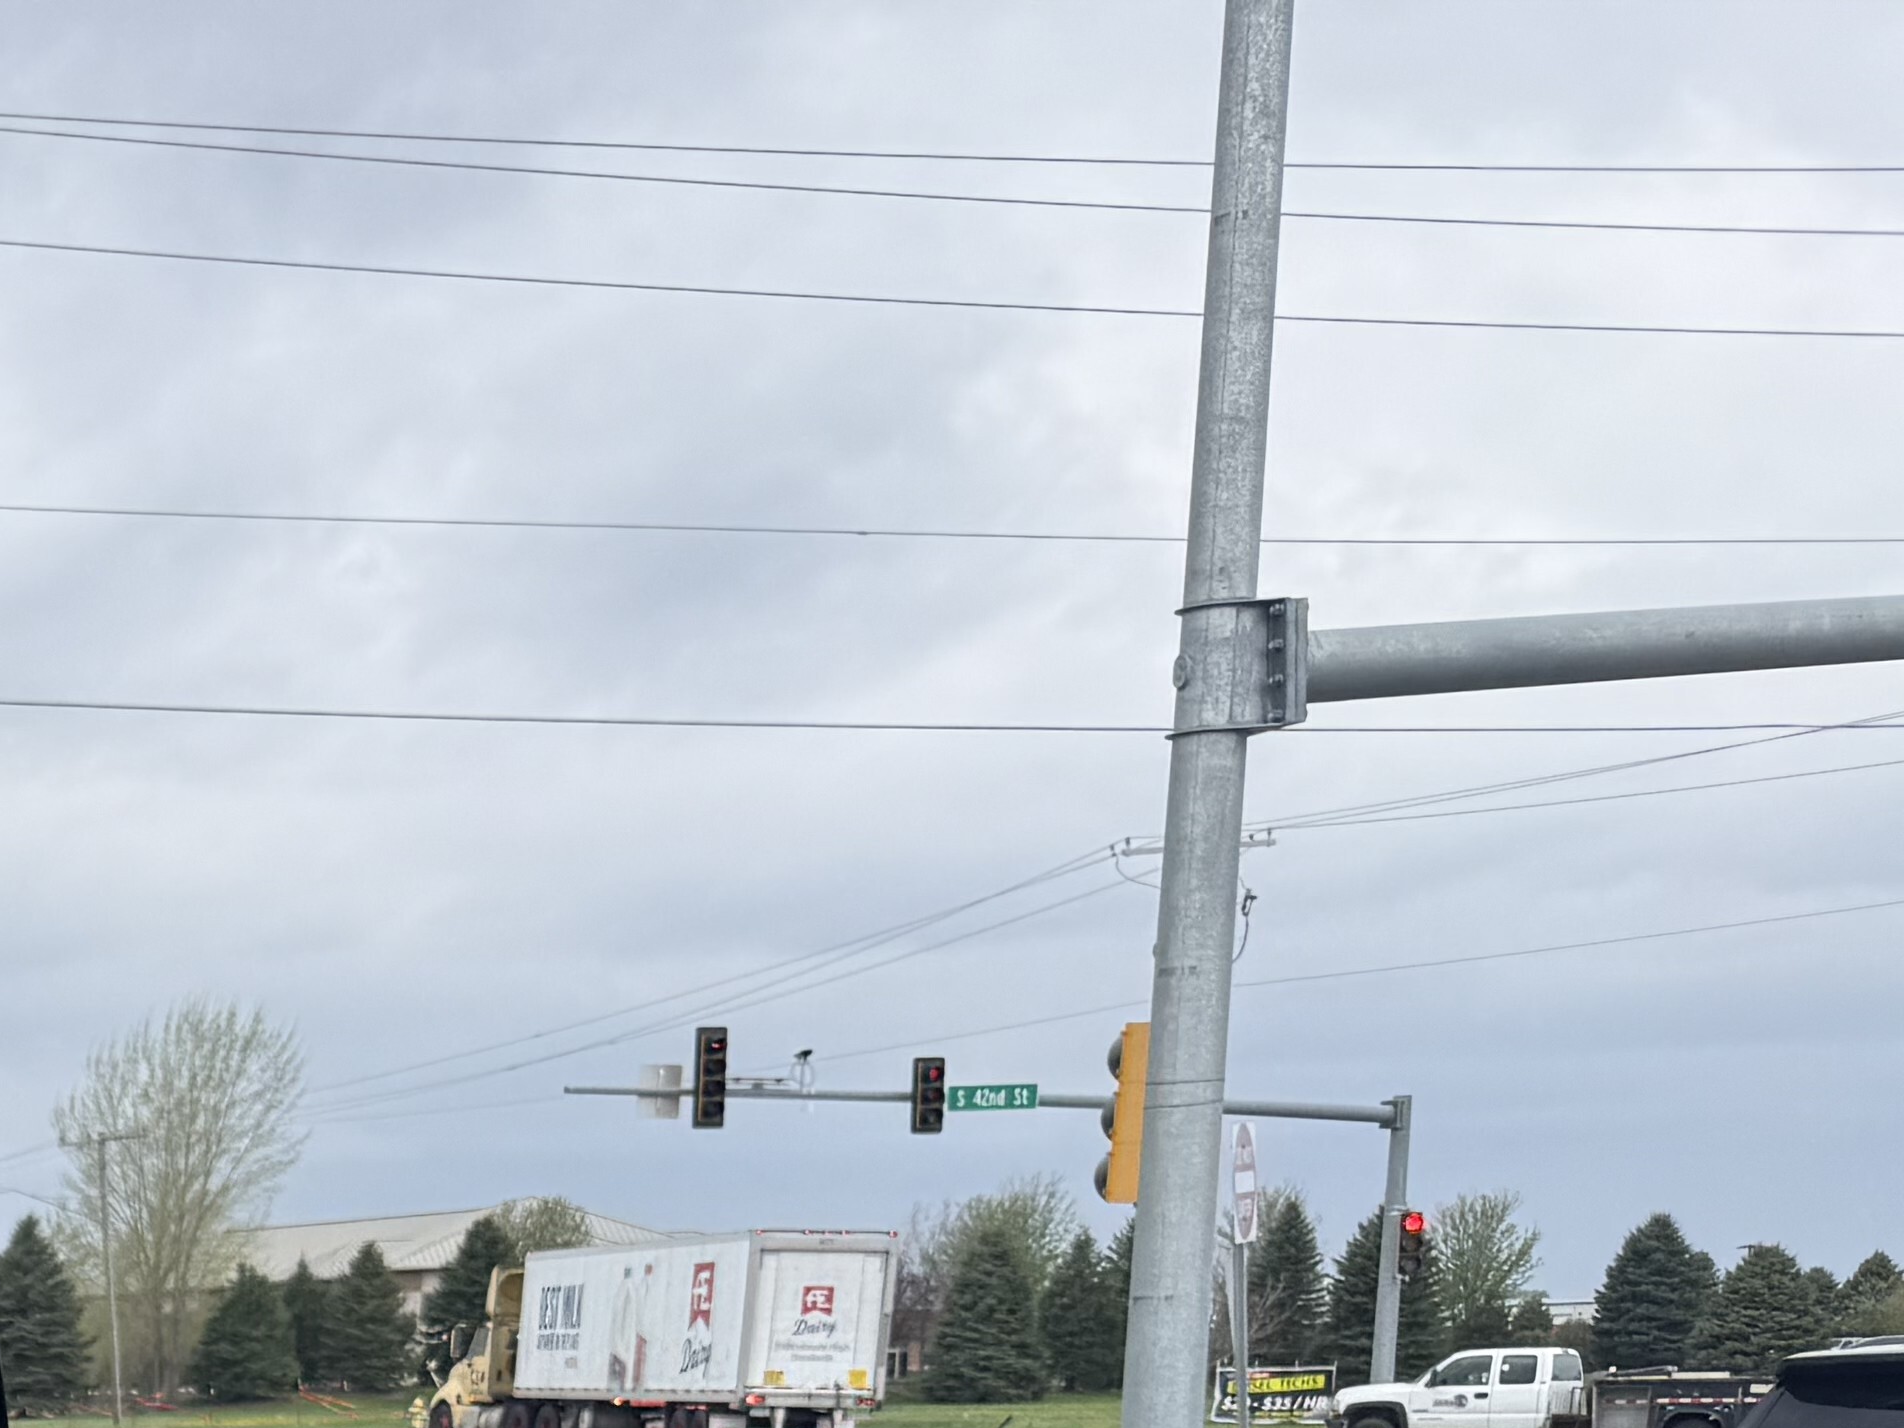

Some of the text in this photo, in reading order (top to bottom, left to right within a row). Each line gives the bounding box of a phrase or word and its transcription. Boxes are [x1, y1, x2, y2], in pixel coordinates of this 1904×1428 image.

[956, 1087, 1028, 1107] S 42nd St
[792, 1317, 837, 1338] Dairy
